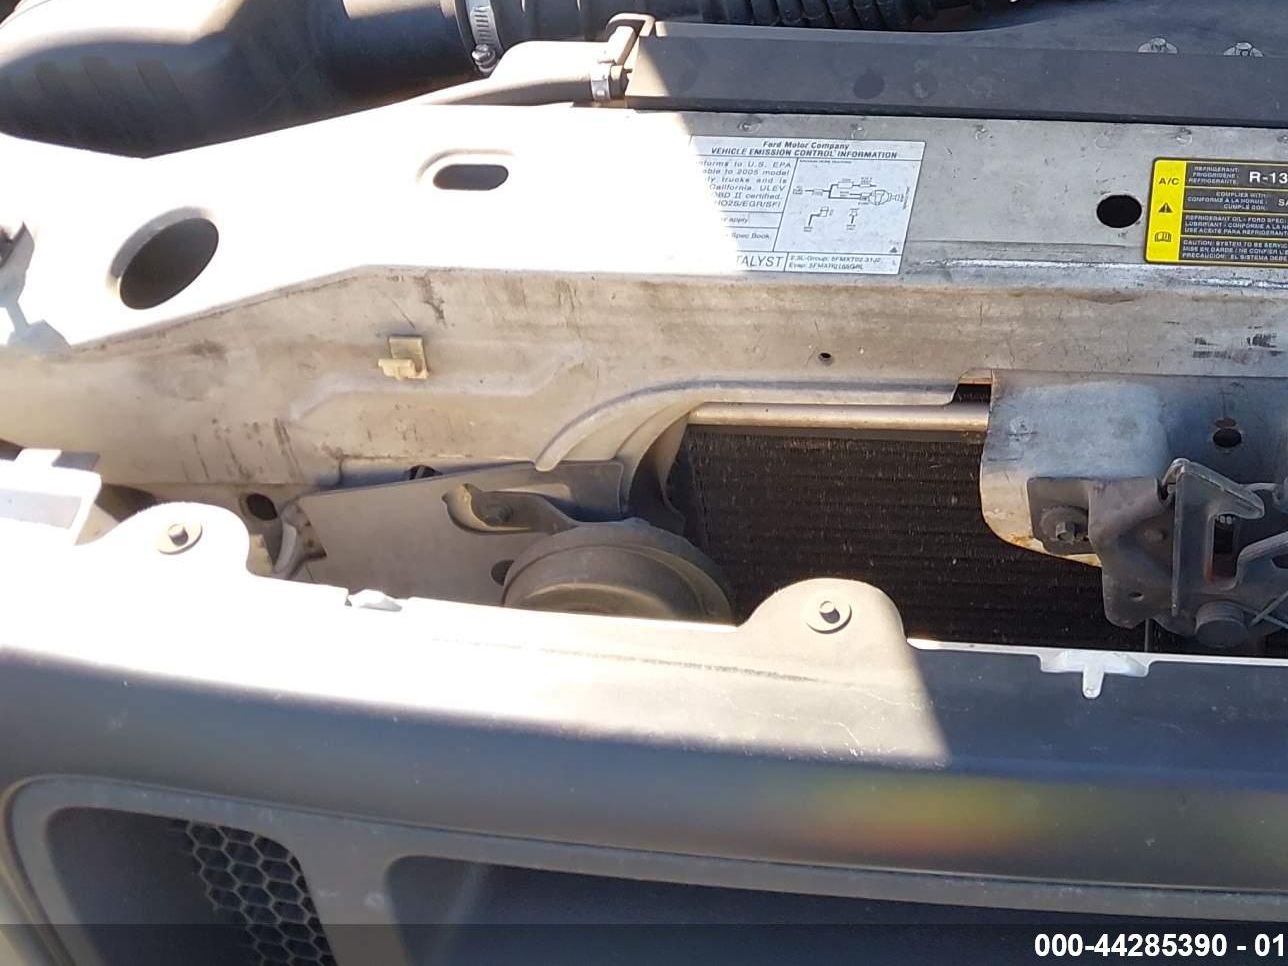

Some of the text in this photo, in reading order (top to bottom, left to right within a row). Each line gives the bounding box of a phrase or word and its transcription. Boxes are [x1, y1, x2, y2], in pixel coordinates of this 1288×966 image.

[763, 140, 850, 150] Ford Motor Company
[711, 147, 898, 159] VEHICLE EMISSION CONTROL INFORMATION
[1158, 177, 1180, 186] A/C
